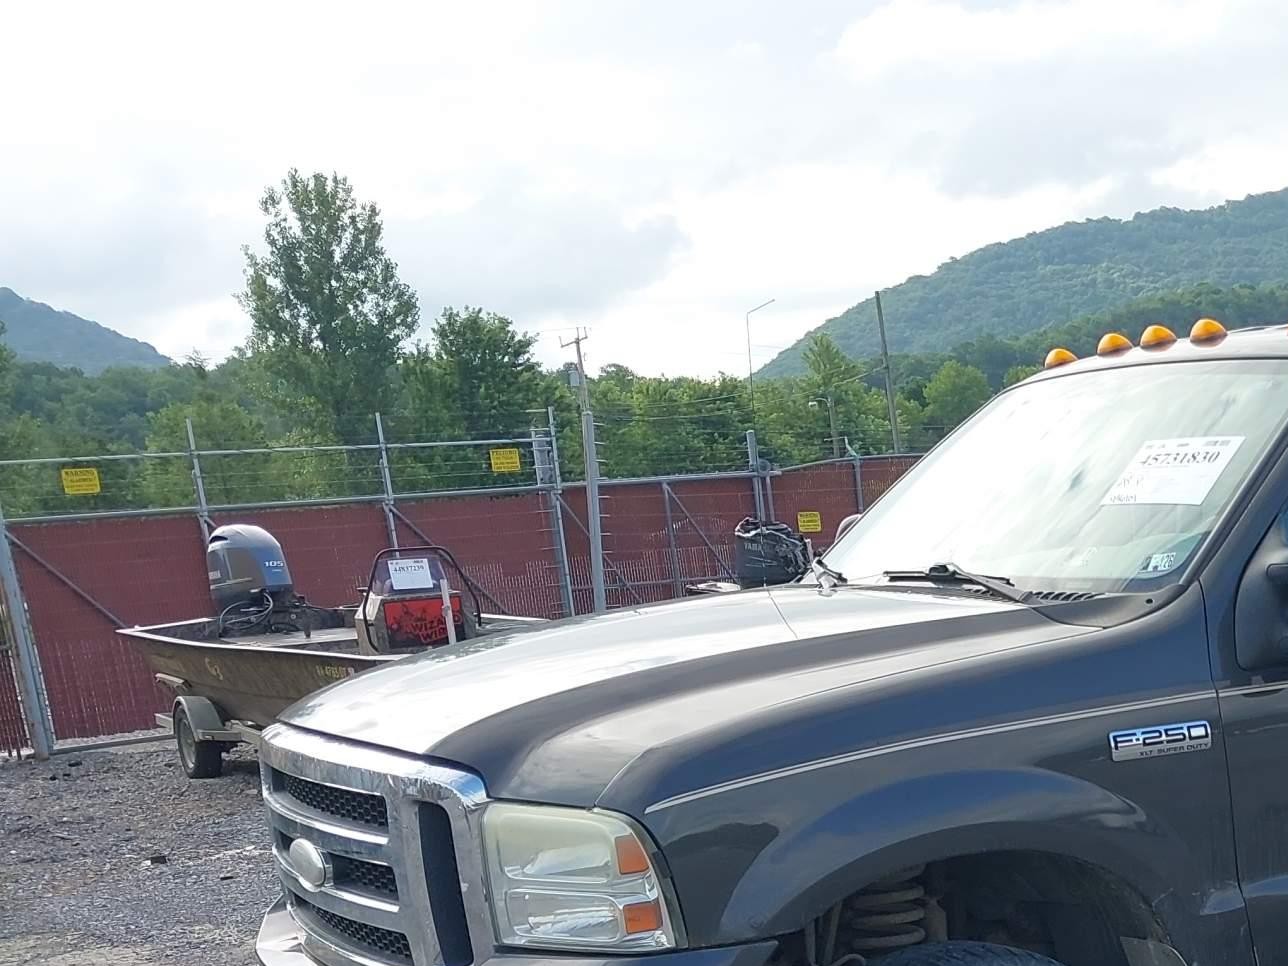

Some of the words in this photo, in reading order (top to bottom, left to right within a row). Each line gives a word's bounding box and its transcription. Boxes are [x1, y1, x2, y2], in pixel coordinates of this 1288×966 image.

[1138, 451, 1220, 466] 45731830
[411, 613, 462, 632] WIZAD
[1157, 745, 1185, 755] SUPER
[1186, 743, 1209, 751] DUTY
